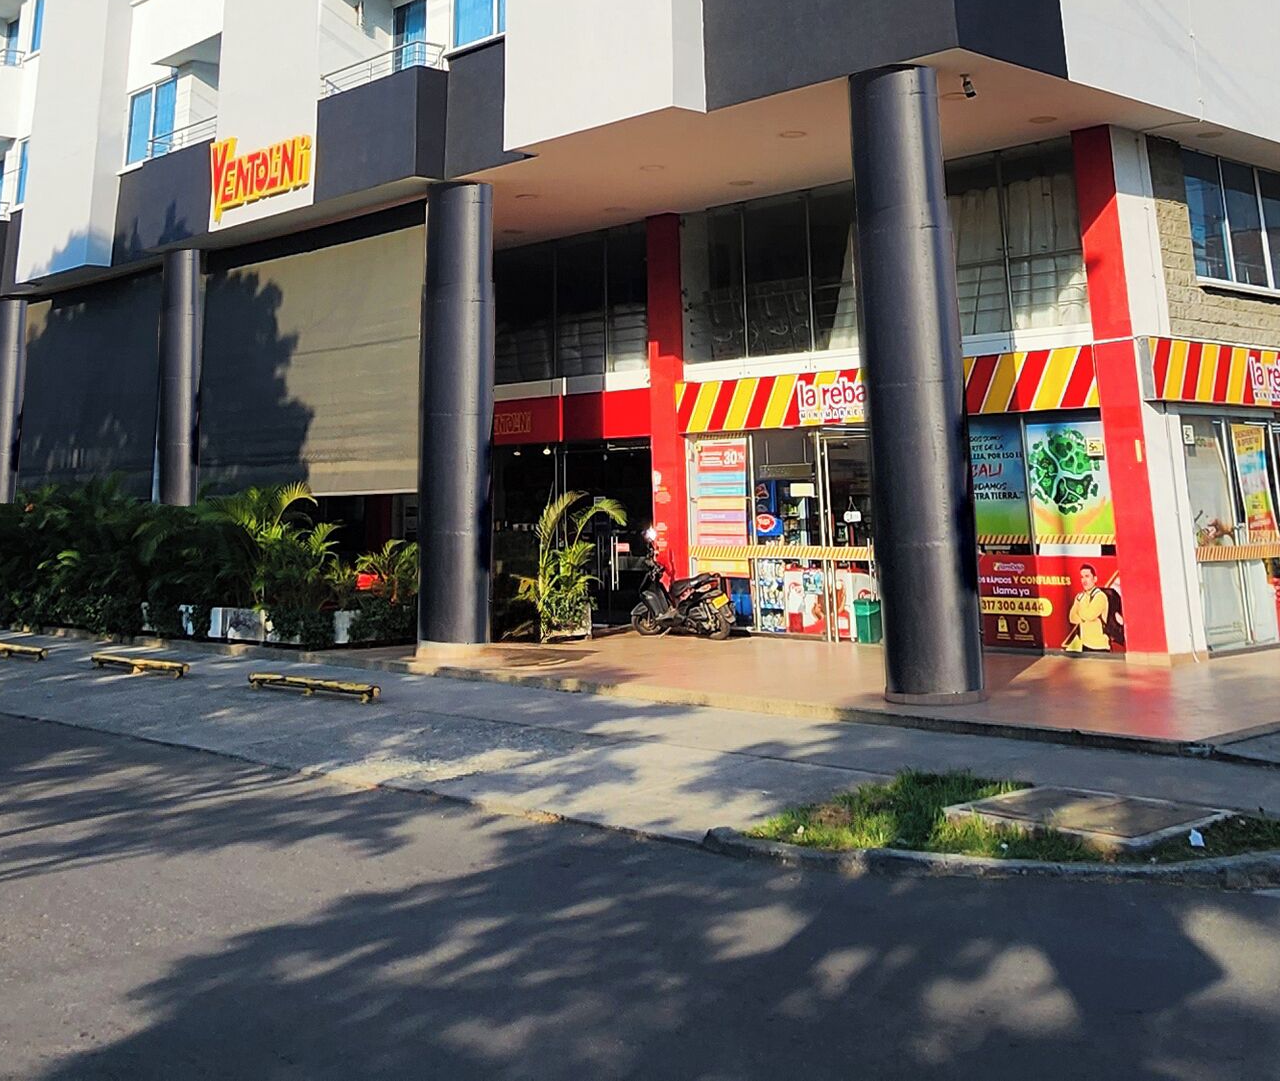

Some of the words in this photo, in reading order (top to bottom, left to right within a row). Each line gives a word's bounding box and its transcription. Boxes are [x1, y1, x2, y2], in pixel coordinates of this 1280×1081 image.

[1249, 359, 1264, 386] la
[799, 382, 816, 408] la
[822, 379, 867, 406] reba
[1012, 575, 1019, 584] Y
[1020, 575, 1071, 586] CONFIABLES
[992, 587, 1018, 596] Llama
[1019, 587, 1030, 596] ya
[981, 600, 997, 611] 317
[998, 600, 1016, 611] 300
